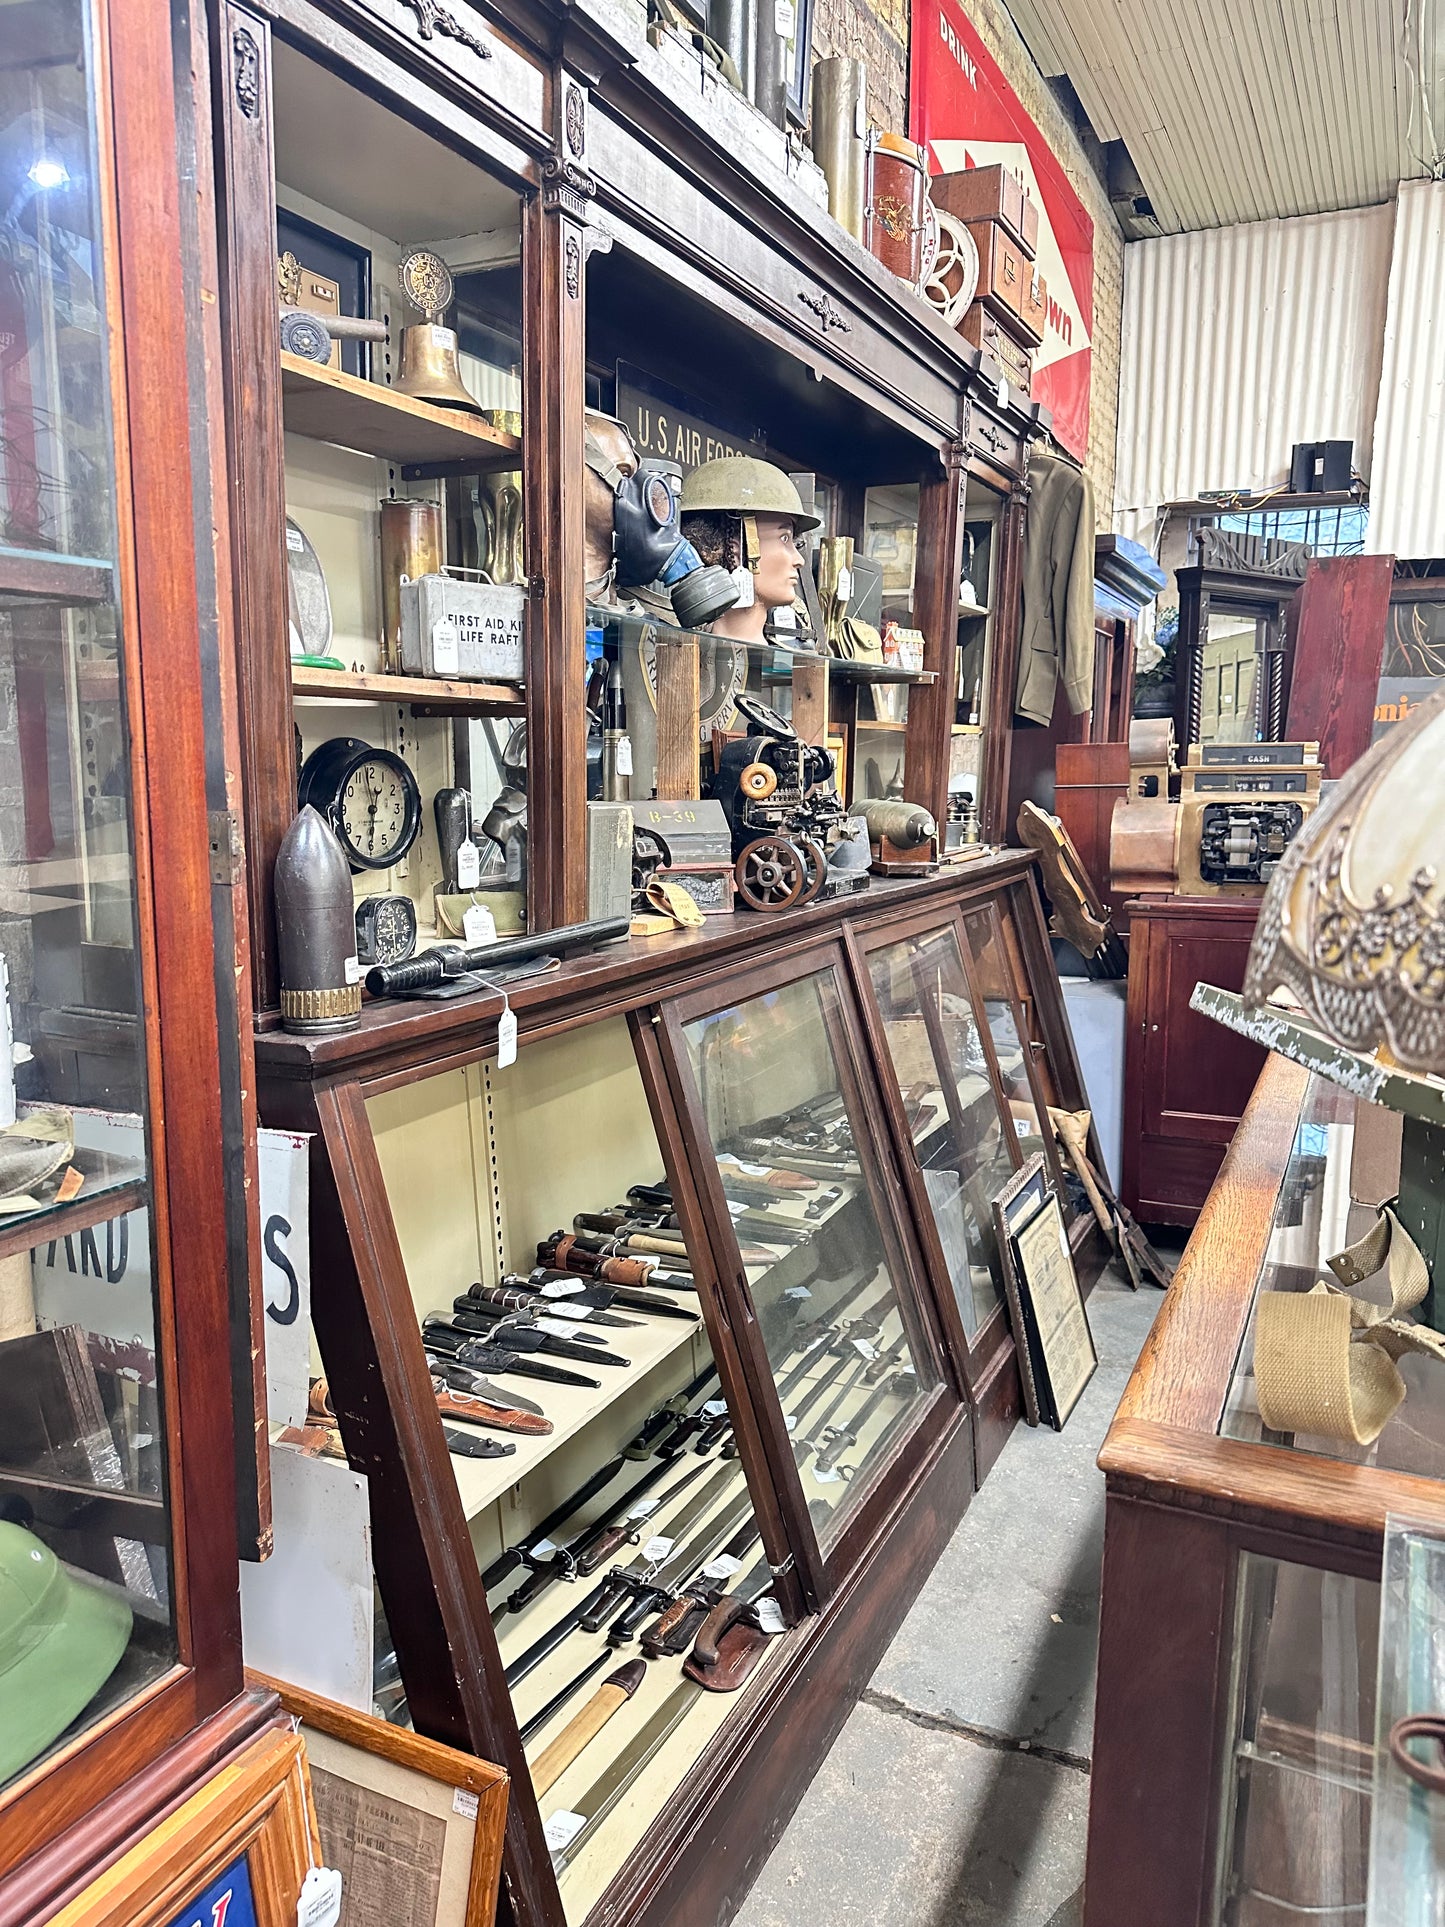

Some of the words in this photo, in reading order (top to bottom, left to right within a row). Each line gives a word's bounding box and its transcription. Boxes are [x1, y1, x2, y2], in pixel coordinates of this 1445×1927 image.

[939, 11, 978, 92] DRINK
[1044, 291, 1072, 347] wn
[674, 424, 701, 467] AIR
[447, 613, 480, 627] FIRST
[485, 618, 504, 630] AID
[460, 630, 484, 643] LIFE
[490, 633, 519, 646] RAFT
[1247, 755, 1270, 764] CASH
[389, 784, 396, 796] 2
[394, 803, 400, 815] 3
[346, 822, 352, 835] 8
[355, 835, 361, 847] 7
[368, 840, 374, 851] 6
[381, 834, 388, 846] 5
